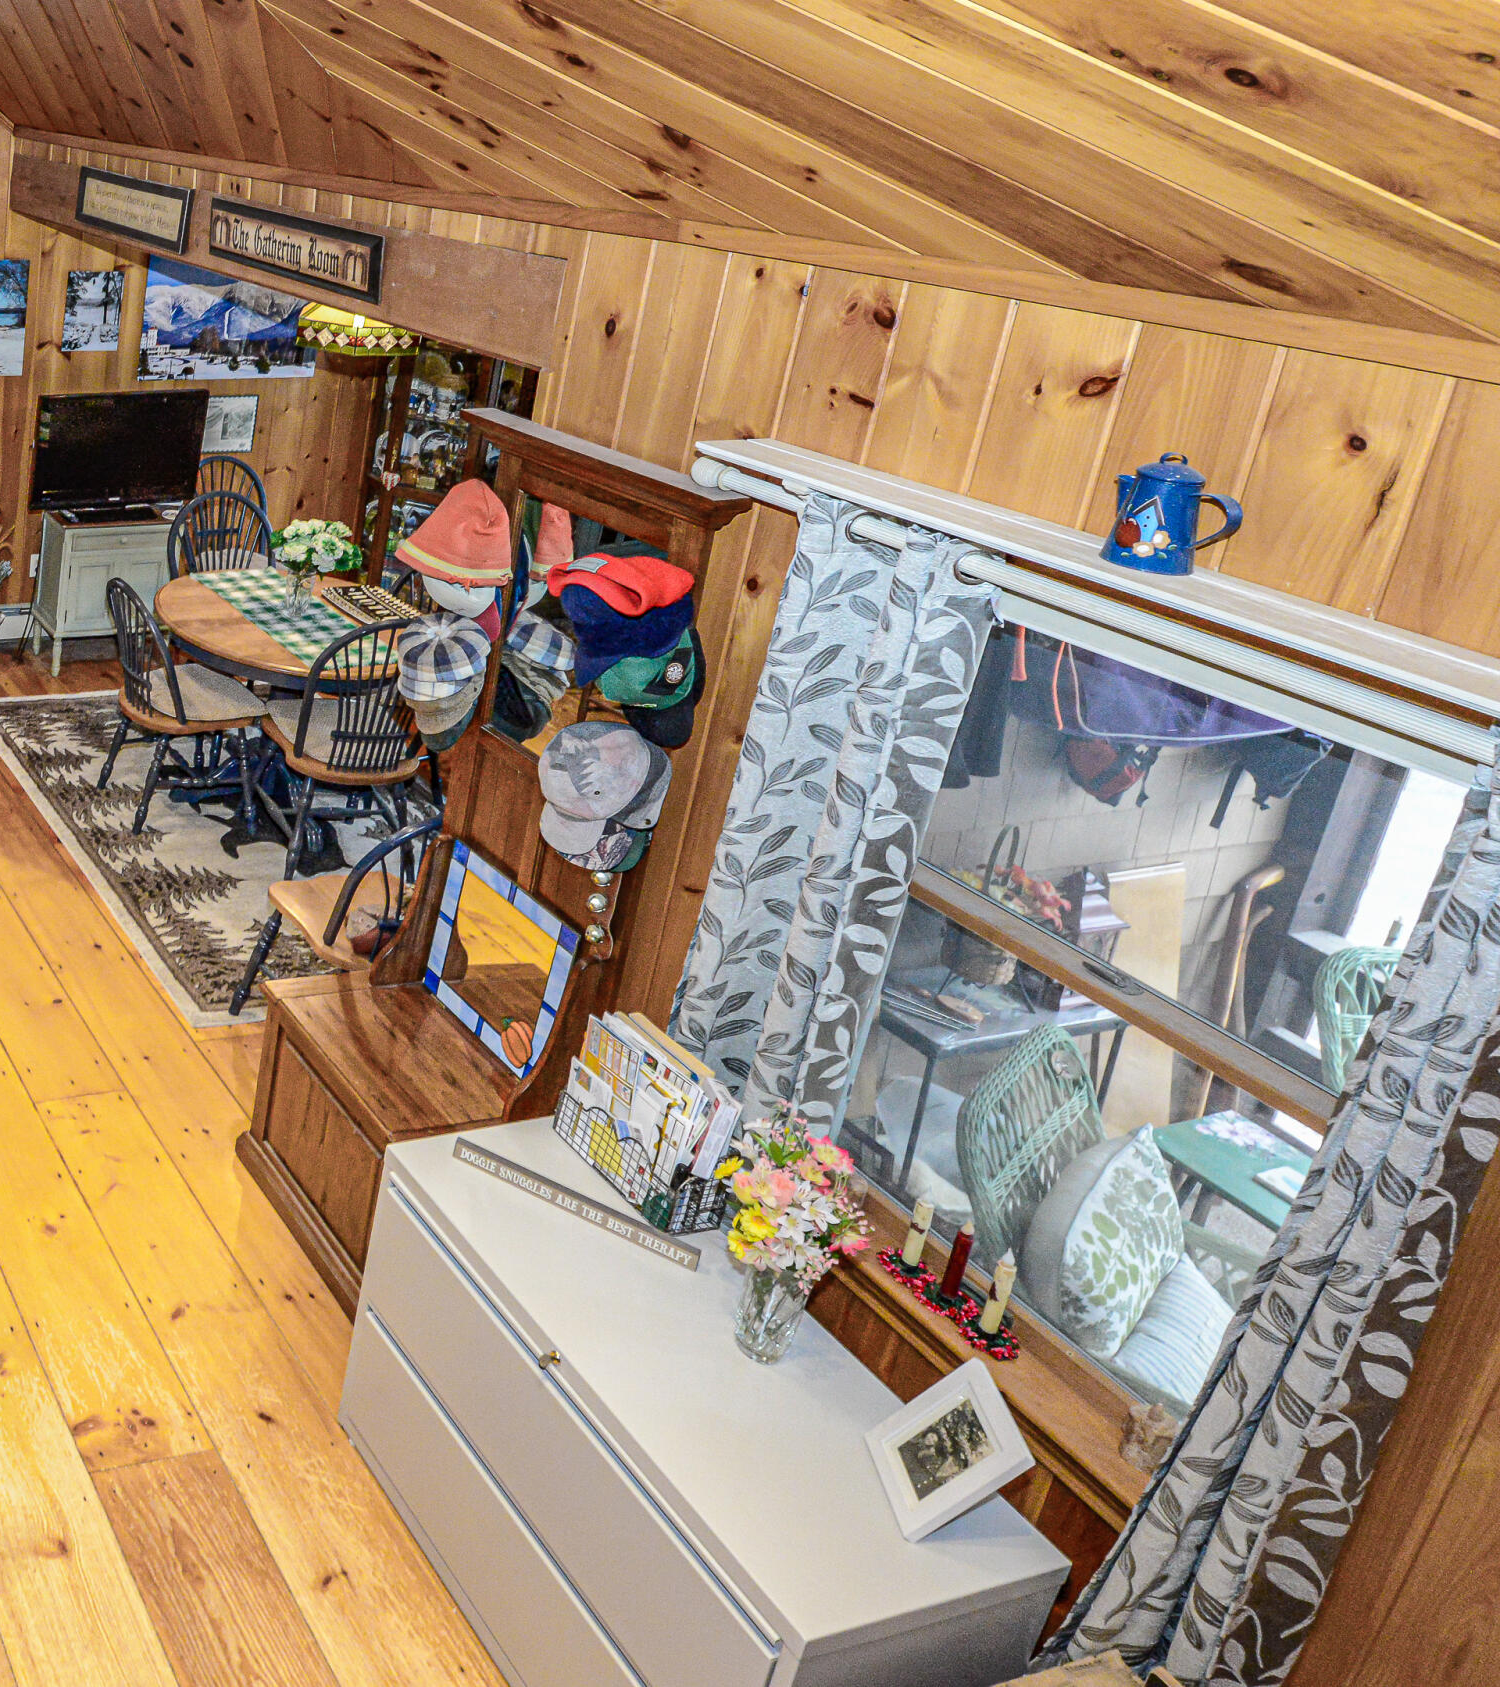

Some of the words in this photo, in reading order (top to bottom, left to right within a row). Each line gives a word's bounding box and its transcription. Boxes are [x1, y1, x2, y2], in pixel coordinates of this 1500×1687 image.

[232, 217, 250, 252] The
[254, 223, 302, 271] Gathering
[308, 236, 339, 278] Room
[460, 1148, 497, 1173] DOGGIE
[498, 1167, 553, 1200] SNUGGLES
[556, 1194, 579, 1212] ARE
[581, 1204, 604, 1224] THE
[606, 1217, 635, 1239] BEST
[638, 1231, 692, 1266] THERAPY
